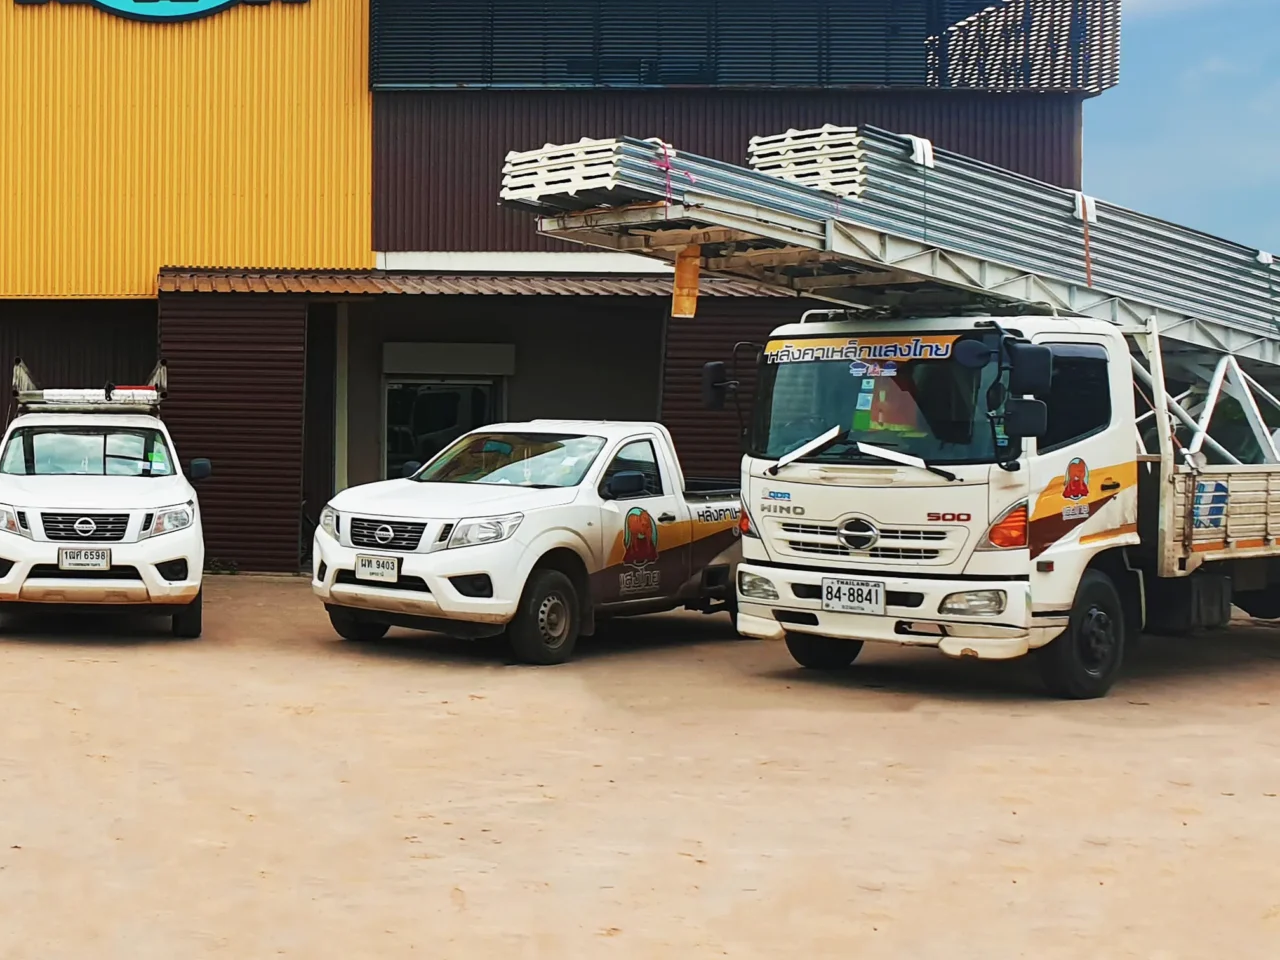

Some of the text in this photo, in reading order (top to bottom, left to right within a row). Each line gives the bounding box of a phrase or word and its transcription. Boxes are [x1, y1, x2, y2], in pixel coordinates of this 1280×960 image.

[769, 338, 951, 364] หลังคาเหล็กแสงไทย
[760, 504, 805, 516] HINO
[927, 512, 971, 522] 500
[83, 551, 106, 560] 6598
[376, 560, 395, 571] 9403
[825, 585, 879, 605] 84-8841
